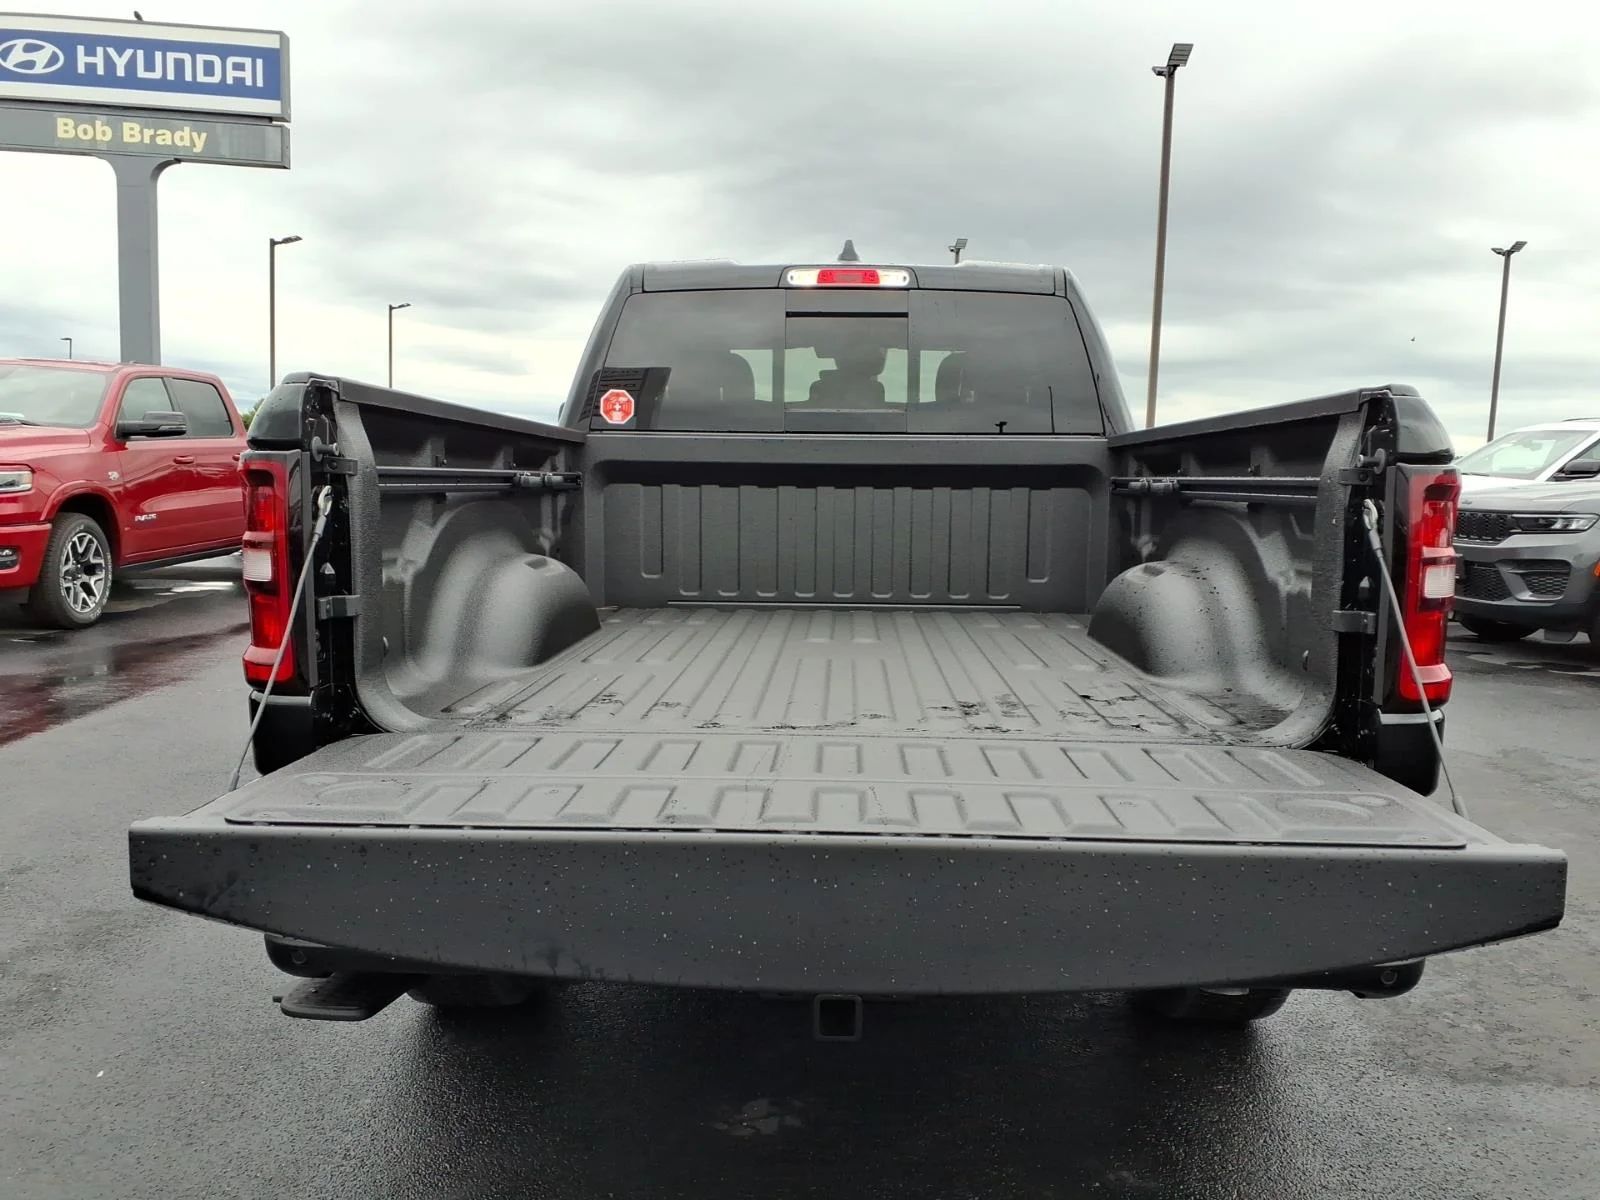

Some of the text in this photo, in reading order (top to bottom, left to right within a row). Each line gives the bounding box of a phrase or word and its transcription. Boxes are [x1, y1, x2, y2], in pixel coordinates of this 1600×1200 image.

[77, 45, 264, 87] HYUNDAI
[56, 117, 208, 153] Bob Brady
